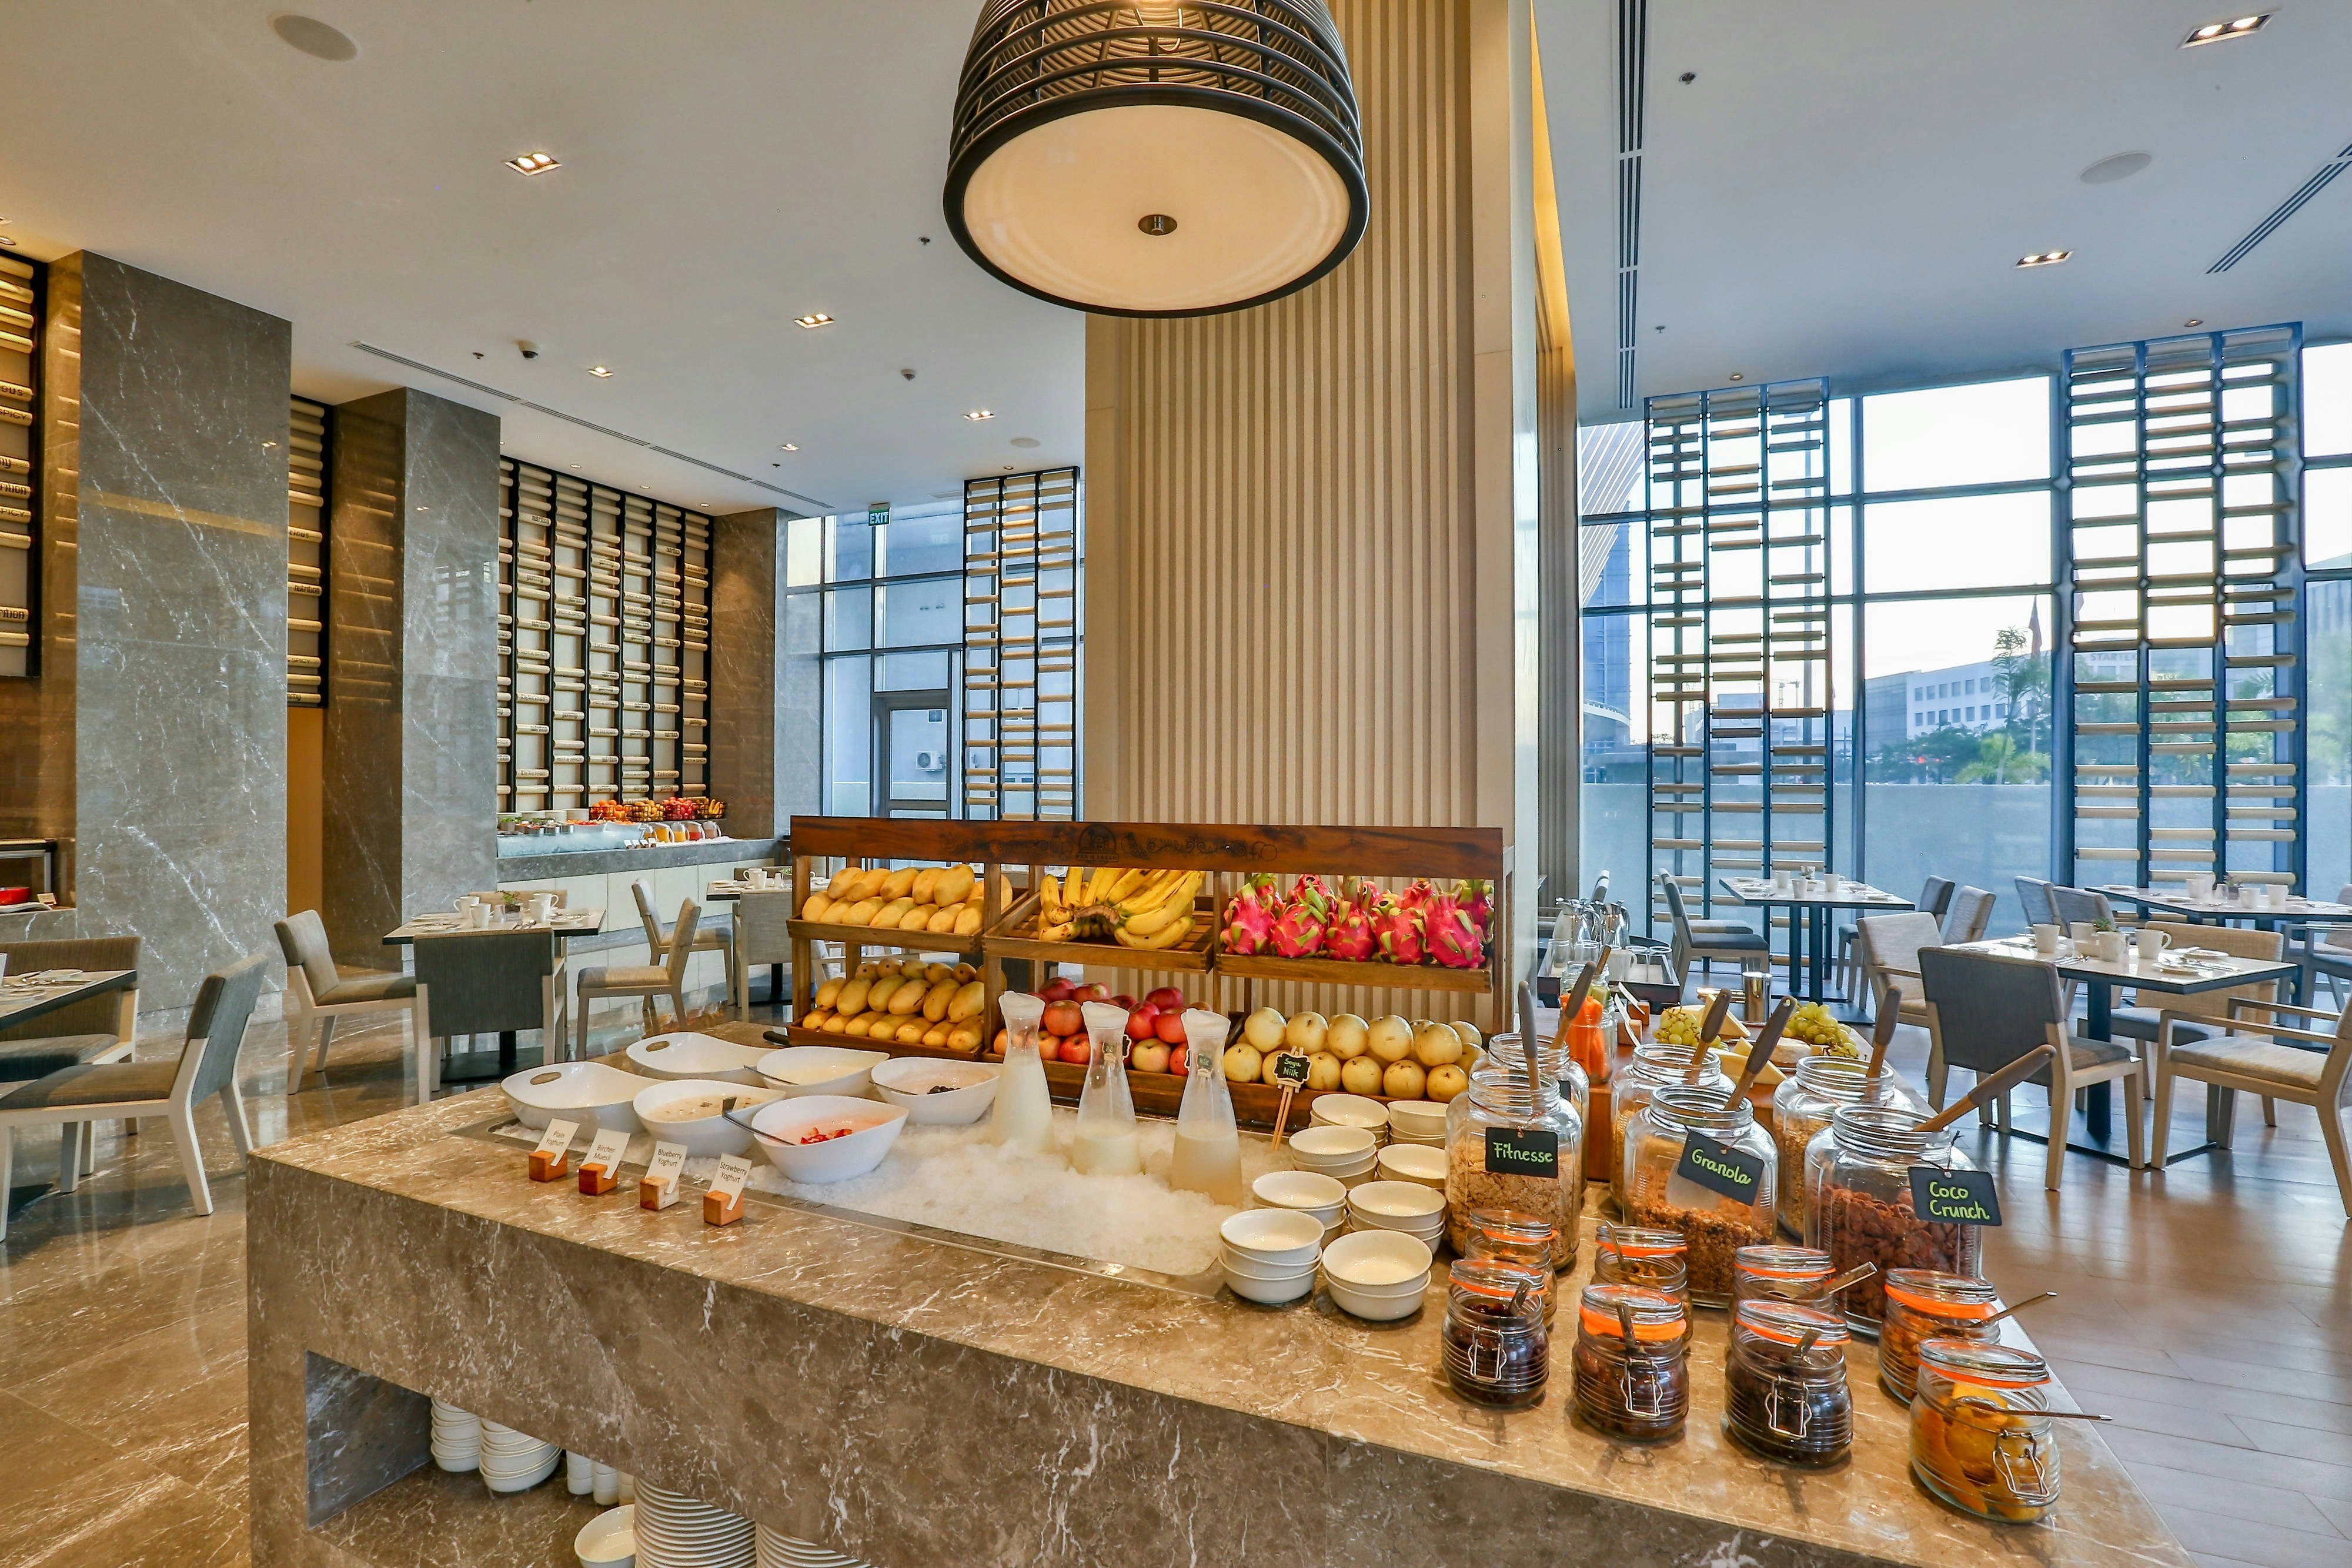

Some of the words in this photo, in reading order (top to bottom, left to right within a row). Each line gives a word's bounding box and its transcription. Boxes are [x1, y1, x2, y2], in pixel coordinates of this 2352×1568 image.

[0, 483, 27, 494] rition
[0, 508, 25, 517] PICY
[870, 511, 889, 524] EXIT
[1284, 1058, 1301, 1068] Soya
[1283, 1067, 1298, 1077] Milk
[546, 1138, 564, 1146] Yoghurt
[597, 1145, 616, 1153] Bircher
[658, 1149, 682, 1159] Blueberry
[1493, 1142, 1553, 1163] Fitnesse
[594, 1152, 612, 1161] Muesli
[658, 1158, 677, 1167] Yoghurt
[1692, 1148, 1752, 1185] Granola
[719, 1162, 748, 1176] Strawberry
[721, 1172, 741, 1183] Yoghurt
[1929, 1181, 1969, 1200] Coco
[1929, 1199, 1990, 1221] Crunch
